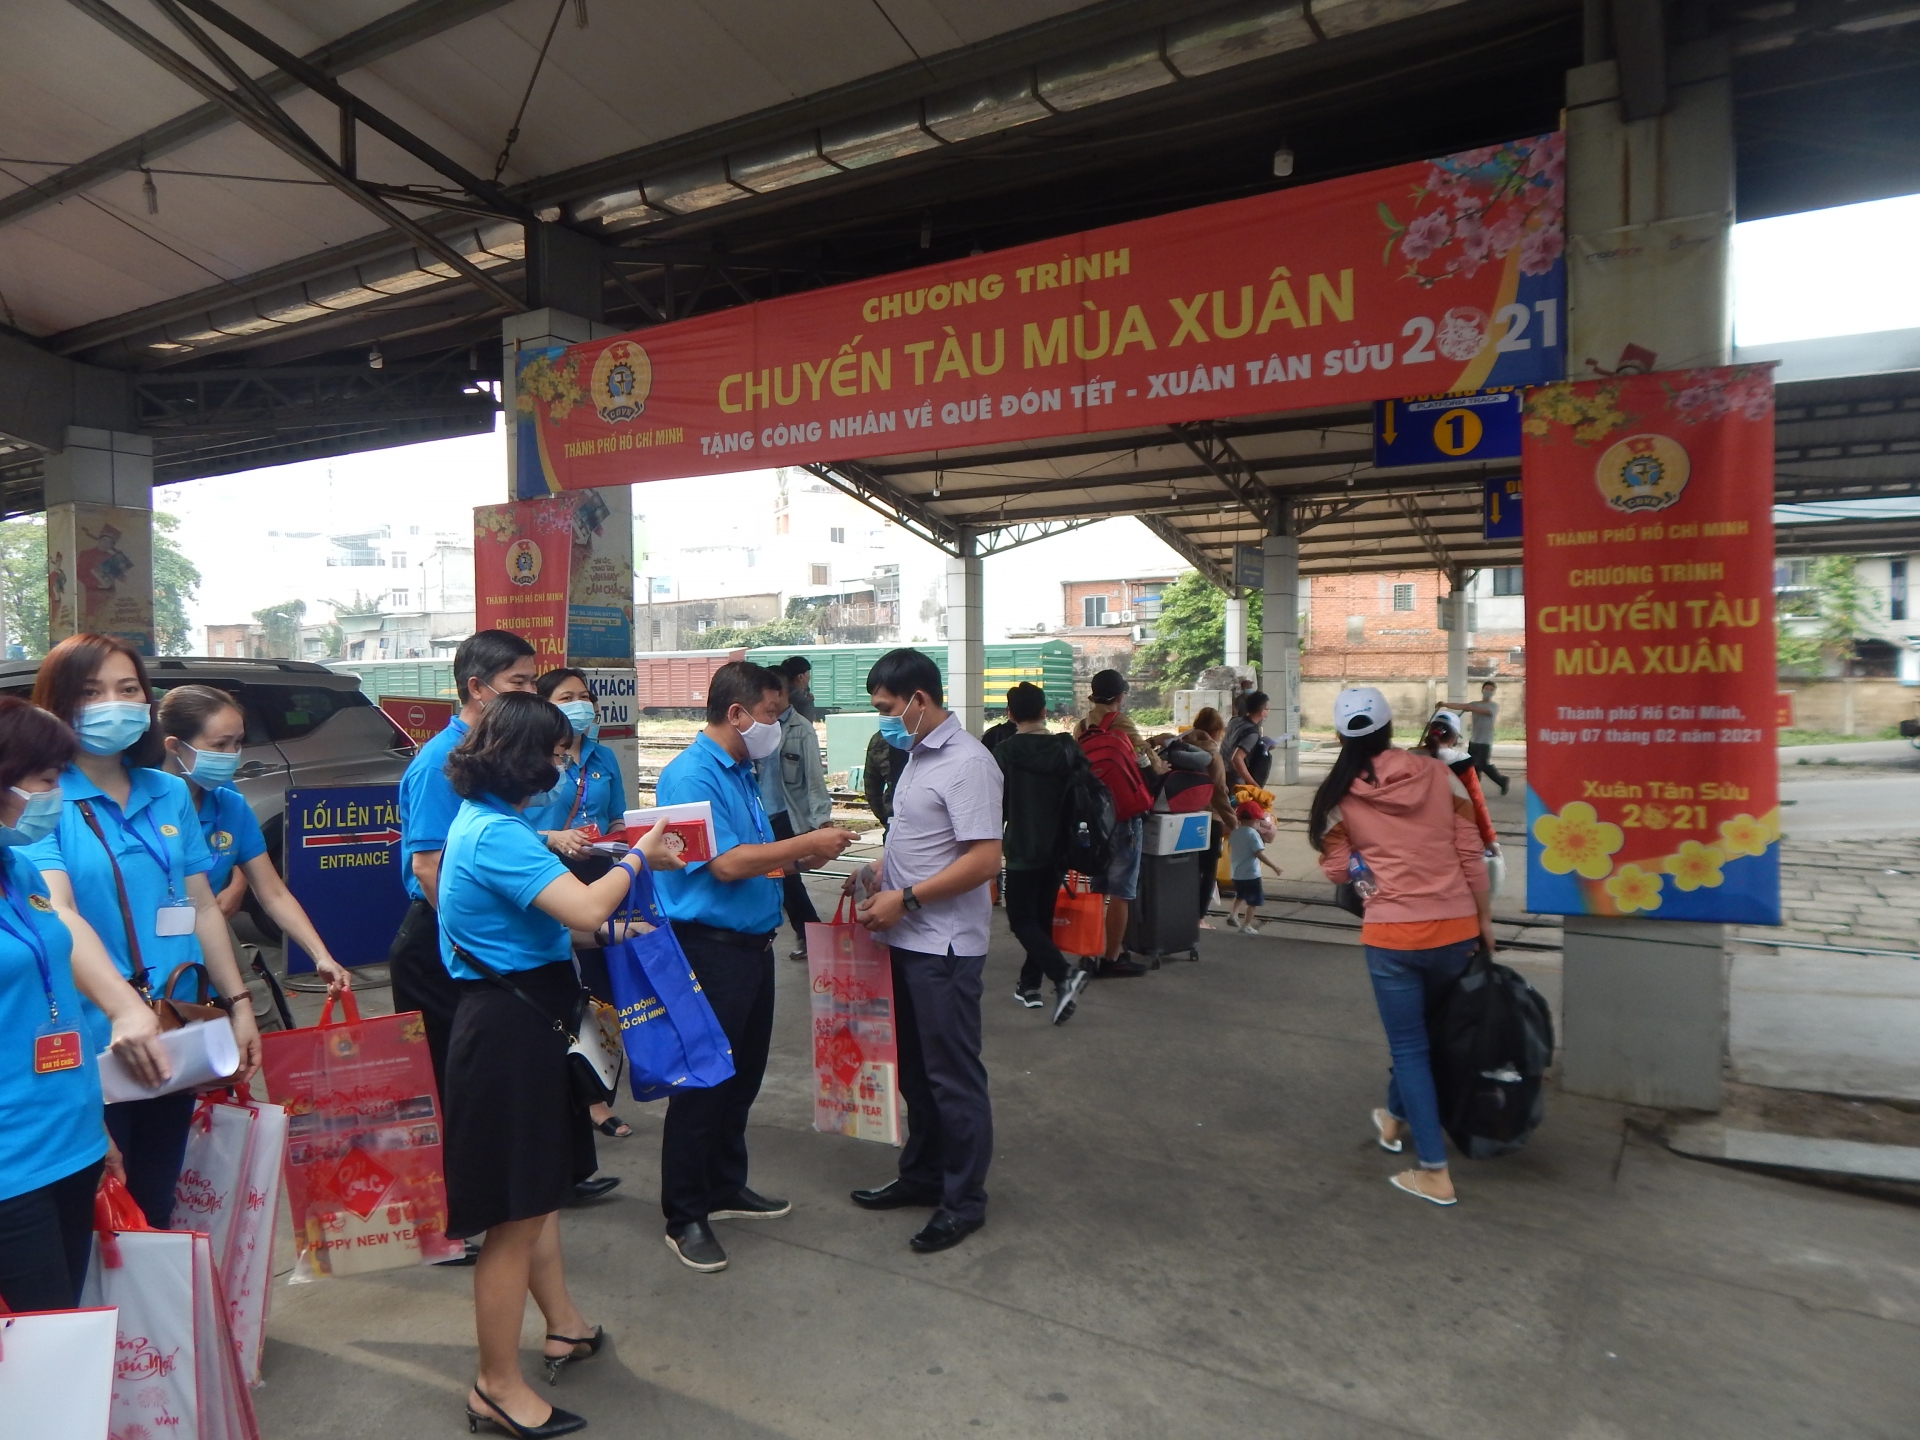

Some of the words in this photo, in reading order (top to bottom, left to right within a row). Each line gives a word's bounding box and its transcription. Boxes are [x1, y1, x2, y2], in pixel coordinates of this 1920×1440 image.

[862, 275, 1005, 323] CHƯƠNG
[1016, 247, 1131, 294] TRÌNH
[718, 334, 891, 415] CHUYẾN
[904, 326, 1005, 386] TÀU
[1023, 301, 1157, 370] MÙA
[1168, 266, 1355, 348] XUÂN
[700, 427, 755, 459] TẶNG
[761, 422, 822, 449] CÔNG
[829, 410, 896, 439] NHÂN
[903, 399, 933, 431] VỀ
[940, 394, 992, 426] QUÊ
[1000, 385, 1061, 418] ĐÓN
[1070, 374, 1115, 409] TẾT
[1146, 363, 1236, 399] XUÂN
[1246, 352, 1312, 387] TÂN
[1322, 339, 1394, 376] SỬU
[1416, 397, 1466, 410] PLATFORM
[1468, 395, 1501, 404] TRACK
[564, 439, 595, 459] THÀNH
[597, 431, 617, 454] PHỐ
[619, 429, 633, 451] HỒ
[635, 428, 653, 449] CHÍ
[655, 427, 684, 446] MINH
[1446, 414, 1465, 450] 1
[1547, 529, 1598, 547] THÀNH
[1603, 523, 1637, 543] PHỐ
[1641, 522, 1664, 541] HỒ
[1668, 521, 1698, 539] CHÍ
[1702, 520, 1749, 537] MINH
[1569, 564, 1654, 588] CHƯƠNG
[1660, 559, 1725, 583] TRÌNH
[486, 594, 508, 605] THÀNH
[534, 591, 545, 602] CHÍ
[546, 592, 564, 602] MINH
[531, 613, 554, 627] TRÌNH
[1538, 590, 1677, 634] CHUYẾN
[1686, 592, 1761, 629] TÀU
[540, 633, 565, 655] TÀU
[1554, 640, 1636, 676] MÙA
[1642, 637, 1744, 674] XUÂN
[589, 675, 636, 697] KHÁCH
[601, 701, 628, 723] TÀU
[1557, 705, 1604, 721] Thành
[1609, 704, 1638, 723] phố
[1642, 704, 1664, 720] Hồ
[1668, 704, 1696, 720] Chí
[1539, 729, 1577, 745] Ngày
[1580, 728, 1602, 742] 07
[1606, 728, 1650, 745] tháng
[1655, 728, 1676, 743] 02
[1681, 728, 1716, 743] năm
[1720, 728, 1762, 742] 2021
[1583, 780, 1643, 798] Xuân
[1649, 780, 1694, 800] Tân
[1701, 780, 1749, 801] Sửu
[303, 799, 331, 830] LỐI
[336, 801, 369, 828] LÊN
[373, 799, 403, 826] TÀU
[320, 851, 390, 870] ENTRANCE
[617, 1006, 633, 1018] LAO
[633, 996, 657, 1012] ĐỘNG
[631, 1012, 648, 1026] CHÍ
[647, 1005, 667, 1020] MINH
[861, 1104, 883, 1117] YEAR
[309, 1238, 352, 1252] HAPPY
[356, 1232, 389, 1249] NEW
[392, 1222, 434, 1242] YEAR
